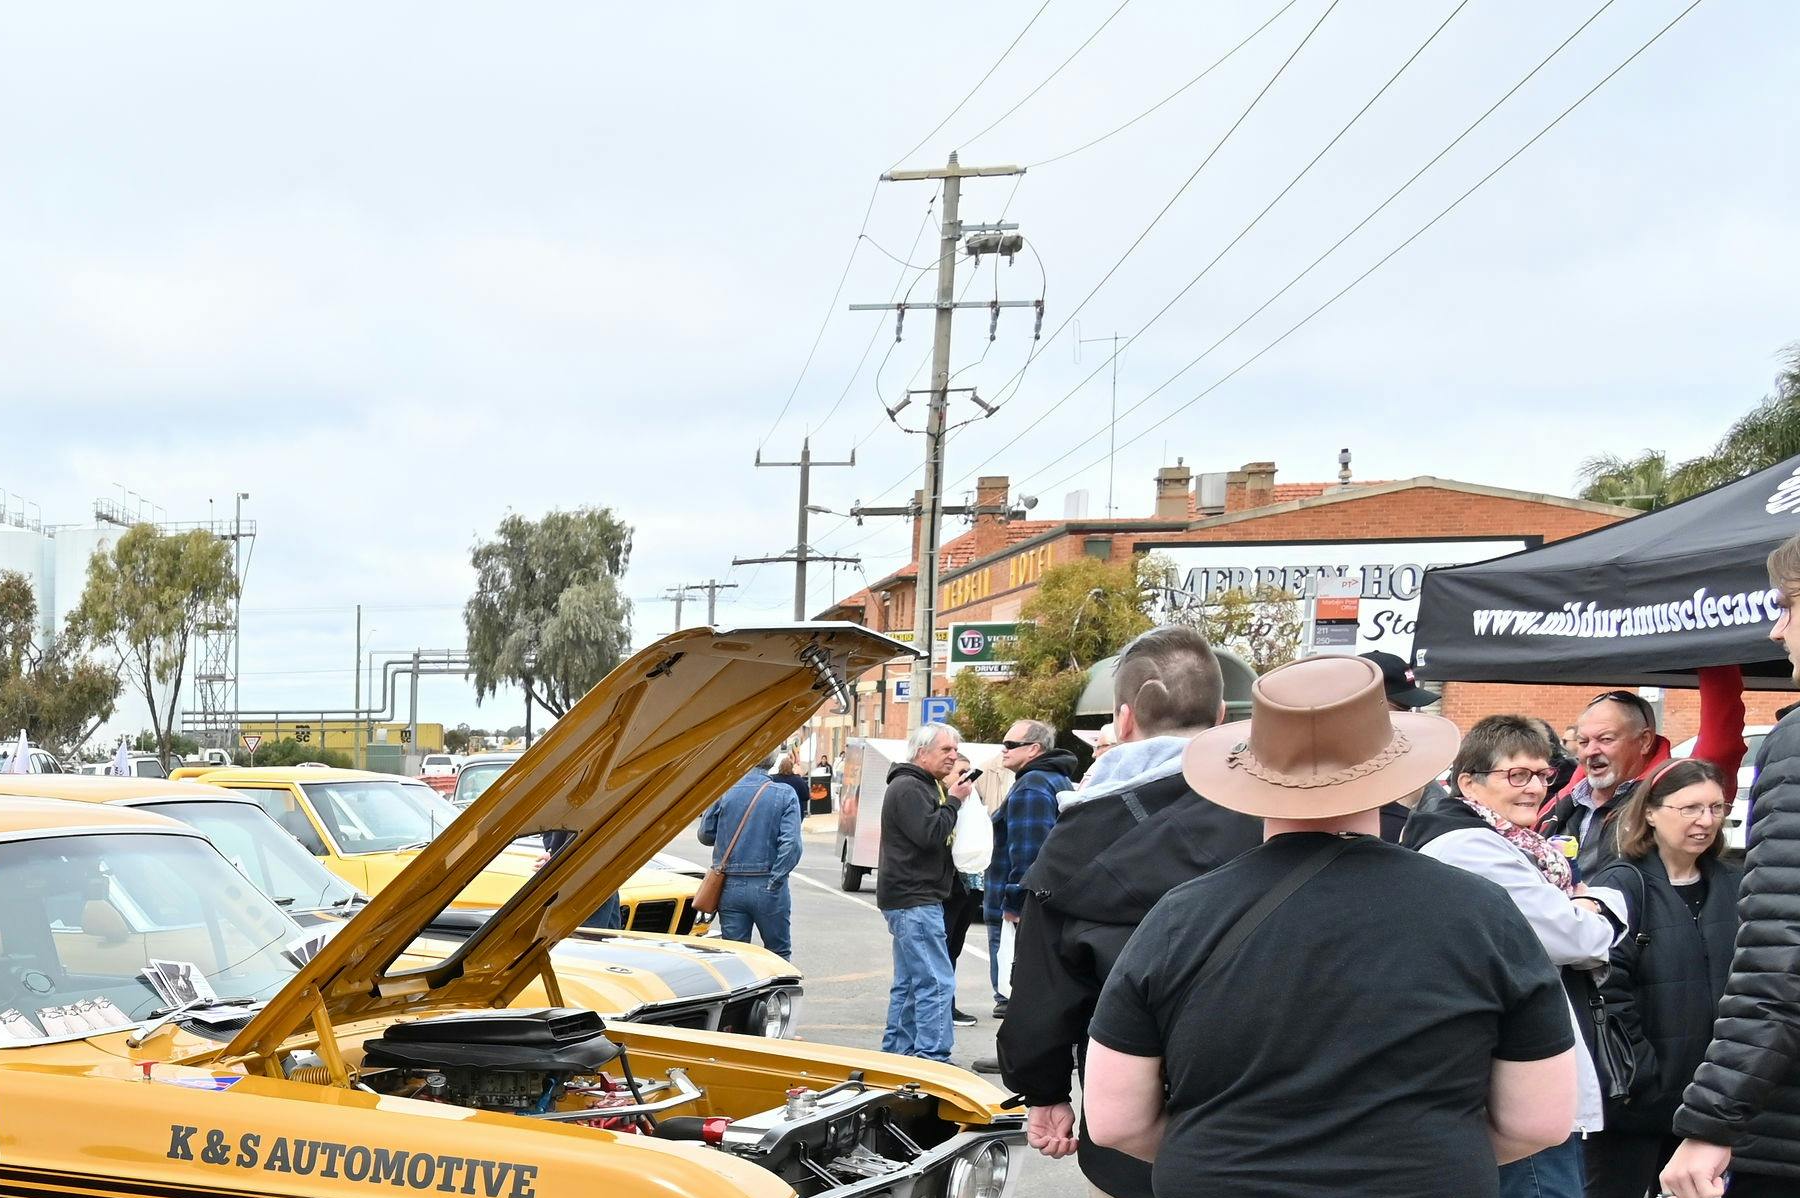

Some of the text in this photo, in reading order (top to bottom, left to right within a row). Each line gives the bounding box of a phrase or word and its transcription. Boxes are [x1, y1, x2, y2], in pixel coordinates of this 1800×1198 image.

[960, 636, 982, 649] VB
[975, 665, 999, 673] DRIVE
[166, 1124, 198, 1161] K
[201, 1128, 231, 1165] &
[236, 1132, 261, 1169] S
